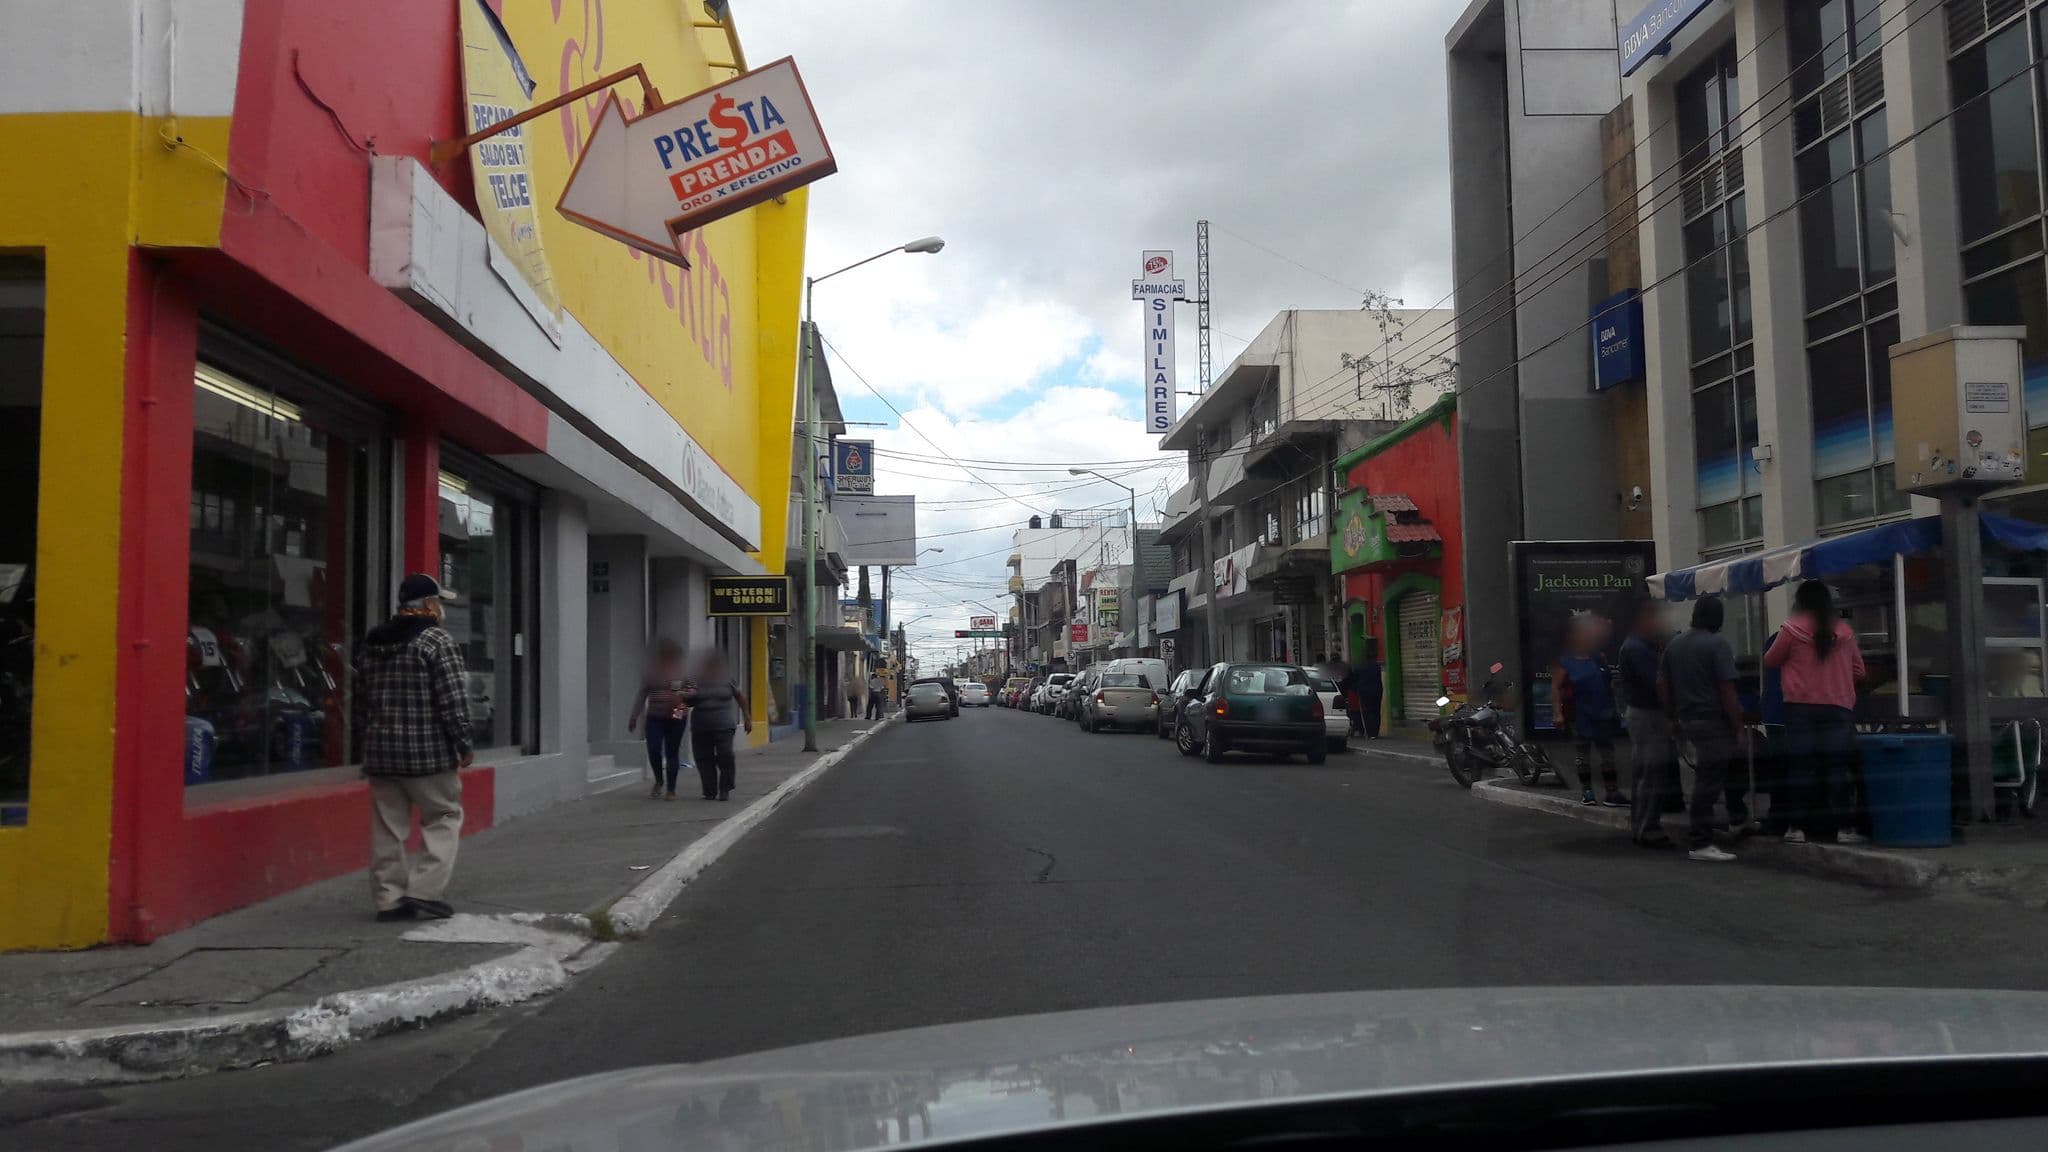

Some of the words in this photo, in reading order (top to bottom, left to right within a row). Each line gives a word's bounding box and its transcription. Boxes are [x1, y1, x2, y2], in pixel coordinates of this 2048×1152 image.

[1623, 23, 1649, 60] BBVA
[679, 139, 787, 194] PRENDA
[680, 193, 713, 212] ORO
[729, 156, 802, 192] EFECTIVO
[1134, 284, 1184, 295] FARMACIAS
[1152, 298, 1169, 429] SIMILARES
[714, 587, 773, 596] WESTERN
[1534, 573, 1599, 592] Jackson
[1603, 574, 1632, 588] Pan
[732, 596, 773, 605] UNION
